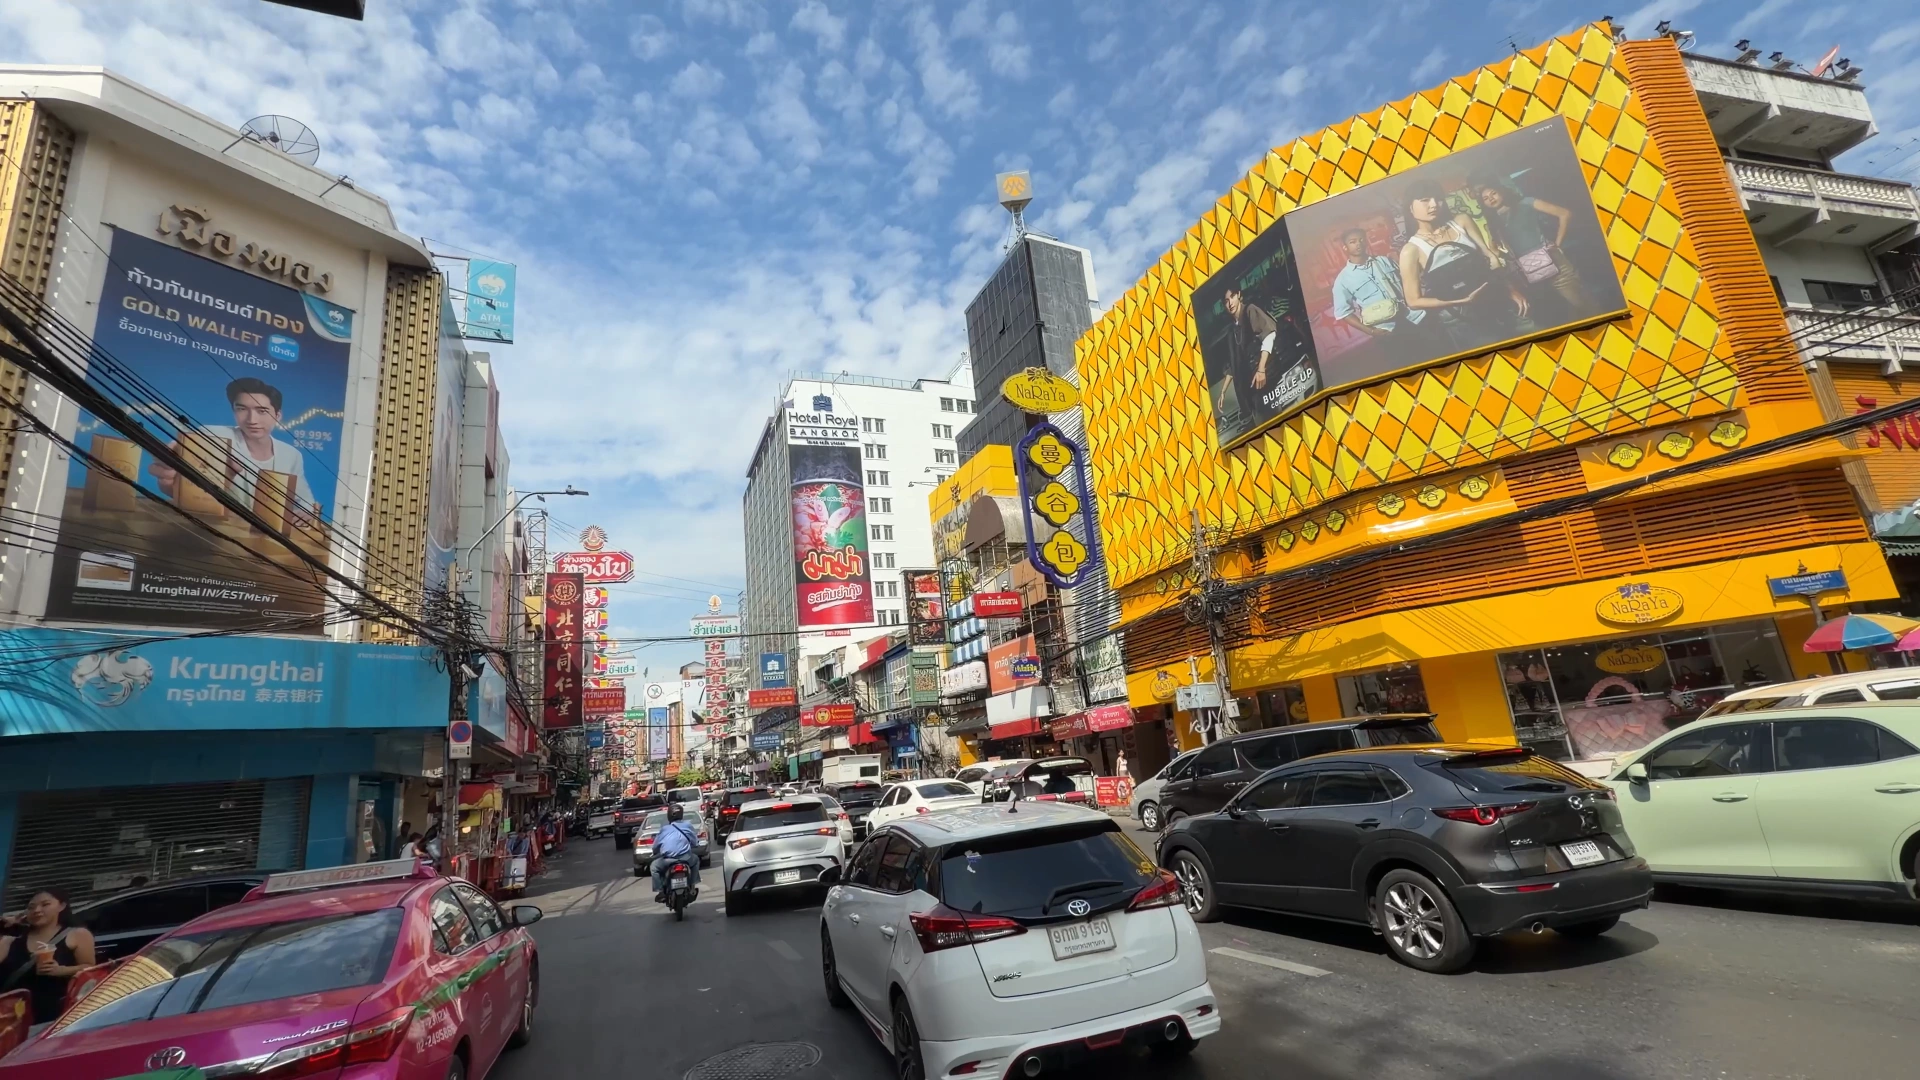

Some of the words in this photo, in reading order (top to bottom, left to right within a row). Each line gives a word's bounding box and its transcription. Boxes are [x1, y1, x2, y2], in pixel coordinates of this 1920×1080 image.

[122, 295, 181, 323] GOLD
[187, 313, 263, 347] WALLET
[480, 313, 501, 322] ATM
[468, 328, 511, 339] EXCHAGE
[1015, 383, 1067, 403] NaRaYa
[1263, 376, 1298, 405] BUBBLE
[1300, 367, 1314, 383] UP
[1270, 384, 1306, 409] COLLECTION
[788, 411, 822, 424] Hotel
[825, 414, 859, 428] Royal
[789, 427, 859, 438] BANGKOK
[141, 583, 200, 597] Krungthai
[202, 587, 279, 603] INVESTMENT
[808, 583, 863, 604] รสต้มยำกุ้ง
[1610, 595, 1669, 616] NaRaYa
[1607, 651, 1653, 666] NaRaYa
[169, 655, 324, 686] Krungthai
[167, 684, 246, 707] กรุงไทย
[255, 688, 324, 704] 泰京银行
[1080, 920, 1108, 939] 9150
[302, 1018, 348, 1036] ALTIS
